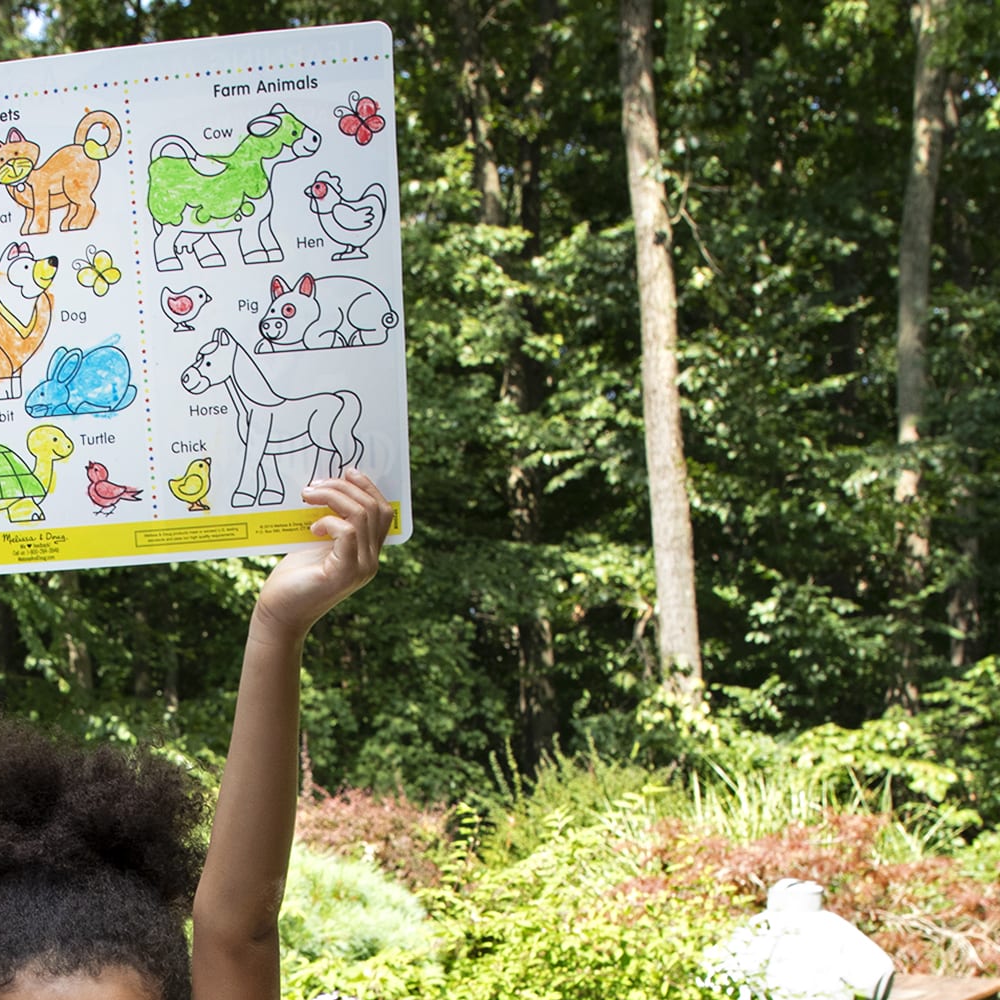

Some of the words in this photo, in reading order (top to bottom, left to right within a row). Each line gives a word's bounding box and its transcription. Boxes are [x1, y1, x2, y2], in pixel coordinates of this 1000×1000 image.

[214, 82, 250, 98] Farm
[256, 75, 319, 94] Animals
[202, 128, 233, 140] Cow
[296, 236, 325, 250] Hen
[238, 299, 259, 313] Pig
[61, 310, 87, 324] Dog
[189, 404, 228, 417] Horse
[80, 432, 116, 447] Turtle
[171, 440, 207, 454] Chick
